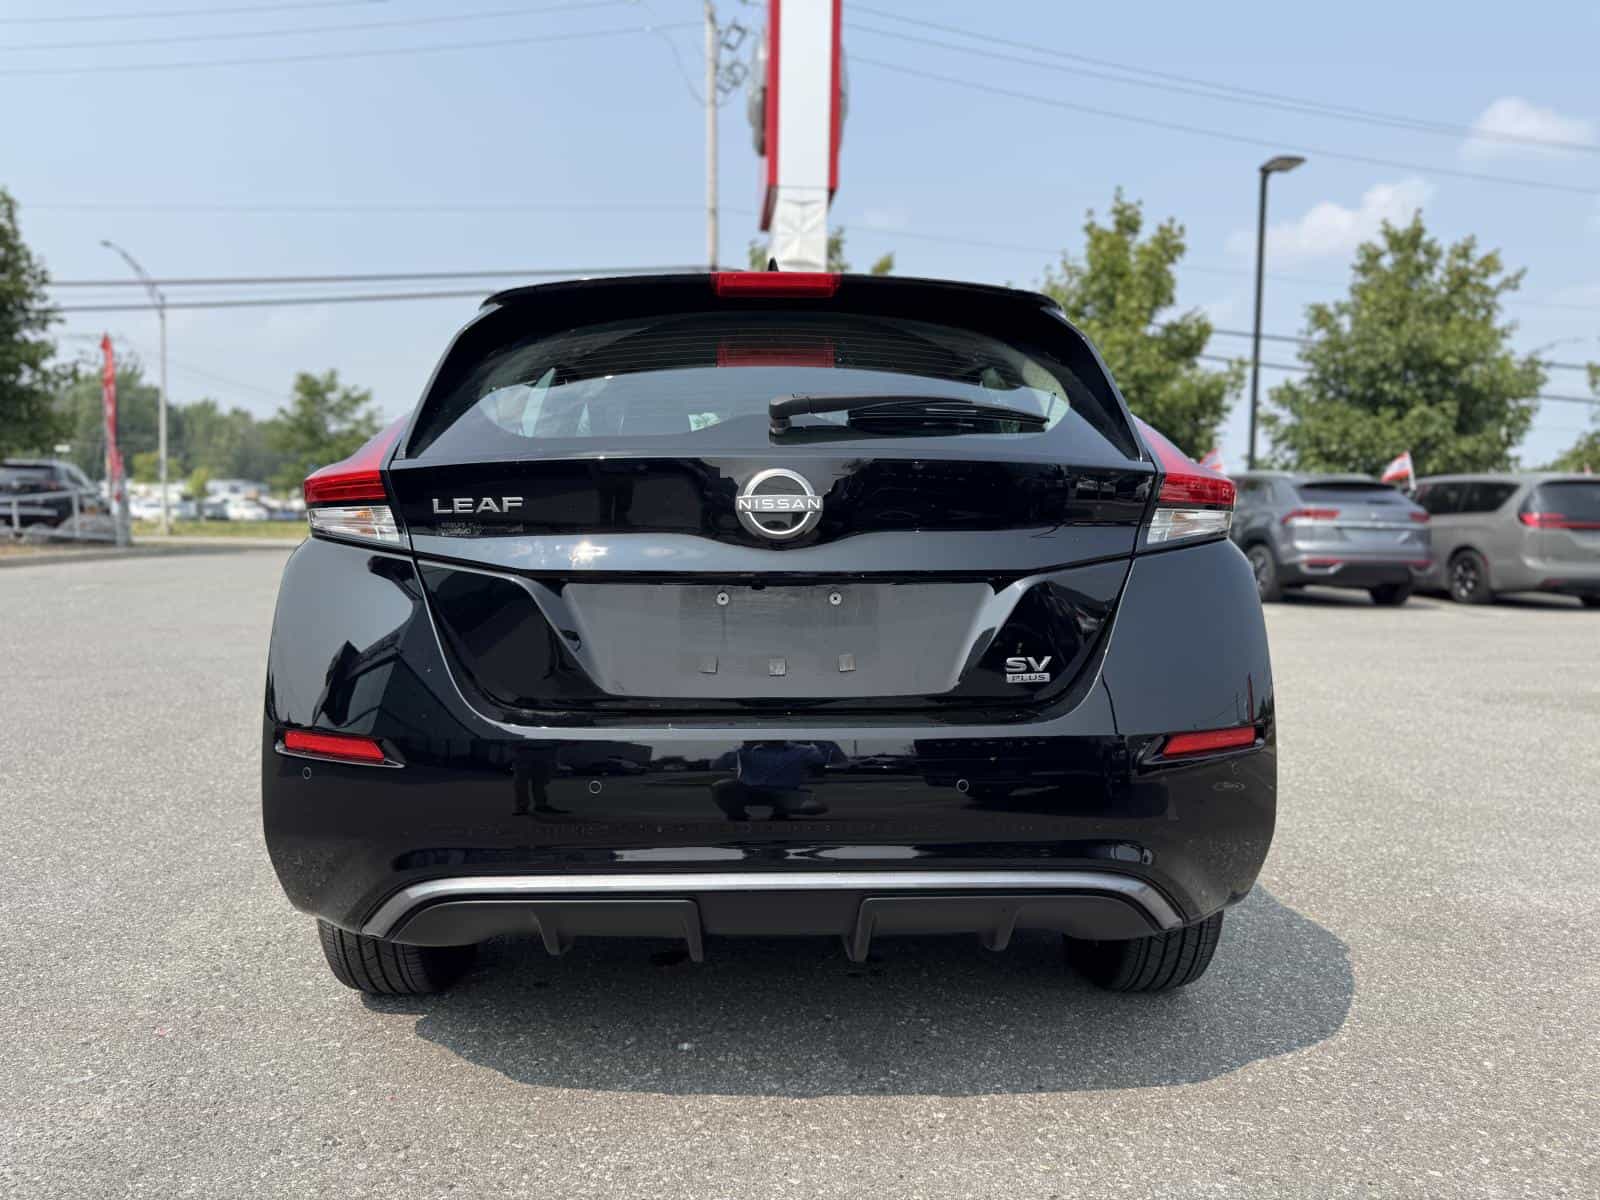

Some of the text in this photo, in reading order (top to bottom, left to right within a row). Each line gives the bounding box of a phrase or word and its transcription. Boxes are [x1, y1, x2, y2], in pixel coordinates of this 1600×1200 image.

[432, 497, 524, 514] LEAF
[738, 498, 820, 510] NISSAN
[1006, 655, 1052, 672] SV
[1009, 673, 1048, 682] PLUS
